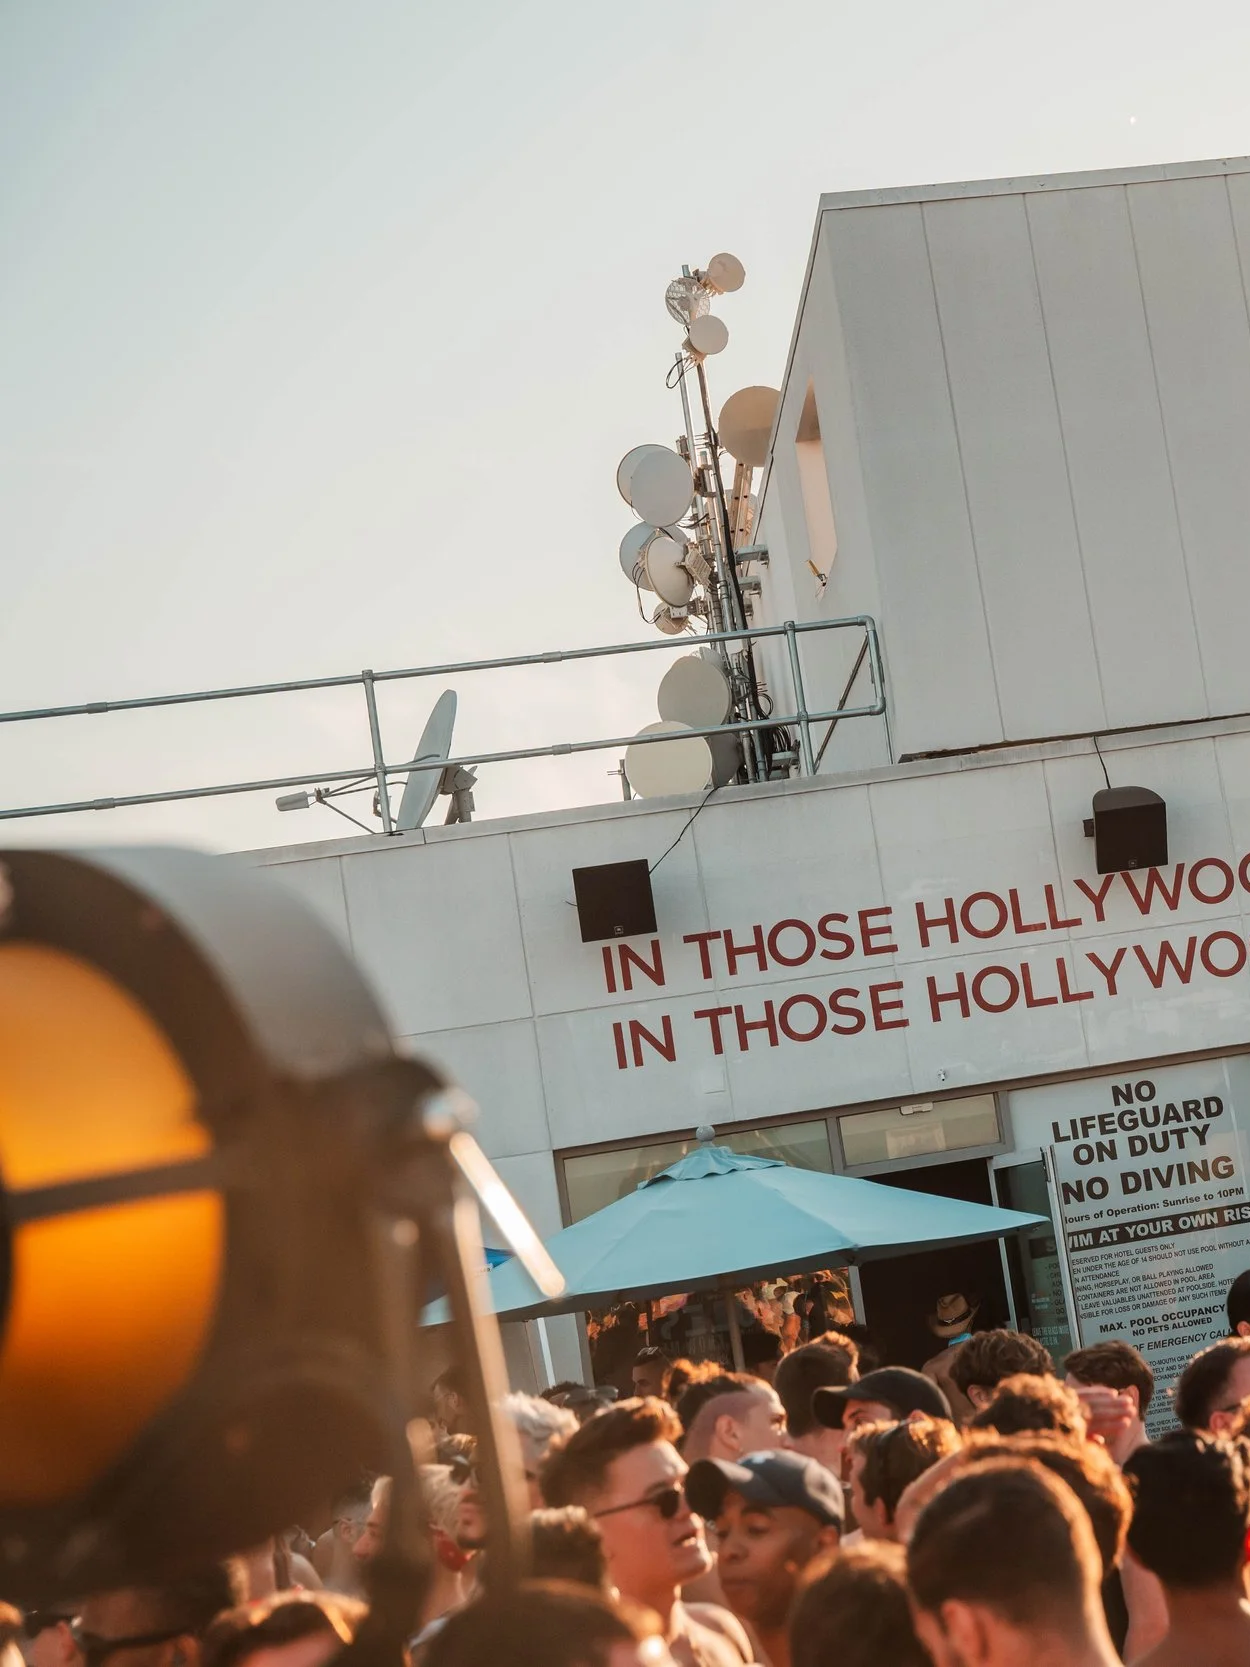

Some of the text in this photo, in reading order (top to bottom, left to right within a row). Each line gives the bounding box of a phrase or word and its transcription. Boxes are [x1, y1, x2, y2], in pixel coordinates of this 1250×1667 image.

[602, 939, 666, 994] IN
[682, 906, 899, 980] THOSE
[612, 1015, 677, 1069] IN
[694, 981, 909, 1057] THOSE
[1111, 1080, 1156, 1106] NO
[1051, 1096, 1224, 1143] LIFEGUARD
[1072, 1123, 1211, 1166] ON DUTY
[1061, 1155, 1235, 1205] NO DIVING
[1065, 1186, 1245, 1224] ours of Operation: Sunrise to 10PM
[1099, 1227, 1120, 1244] AT
[1124, 1220, 1174, 1239] YOUR
[1178, 1211, 1219, 1230] OWN
[1072, 1256, 1100, 1265] ESERVED
[1114, 1250, 1134, 1258] HOTEL
[1135, 1246, 1159, 1254] GUESTS
[1082, 1264, 1103, 1272] UNDER
[1148, 1252, 1173, 1261] SHOULD
[1218, 1240, 1245, 1249] WITHOUT
[1077, 1290, 1115, 1301] CONTAINERS
[1143, 1280, 1173, 1289] ALLOWED
[1180, 1275, 1197, 1283] POOL
[1198, 1272, 1216, 1280] AREA
[1080, 1270, 1120, 1282] ATTENDANCE
[1142, 1273, 1156, 1281] BALL
[1158, 1269, 1184, 1278] PLAYING
[1185, 1263, 1214, 1273] ALLOWED
[1081, 1301, 1100, 1310] LEAVE
[1101, 1295, 1136, 1306] VALUABLES
[1137, 1288, 1177, 1300] UNATTENDED
[1114, 1305, 1131, 1313] LOSS
[1142, 1299, 1168, 1308] DAMAGE
[1178, 1294, 1191, 1302] ANY
[1191, 1292, 1209, 1300] SUCH
[1209, 1289, 1227, 1297] ITEMS
[1099, 1304, 1226, 1333] MAX. POOL OCCUPANCY
[1132, 1317, 1213, 1337] NO PETS ALLOWED
[1147, 1332, 1208, 1350] EMERGENCY
